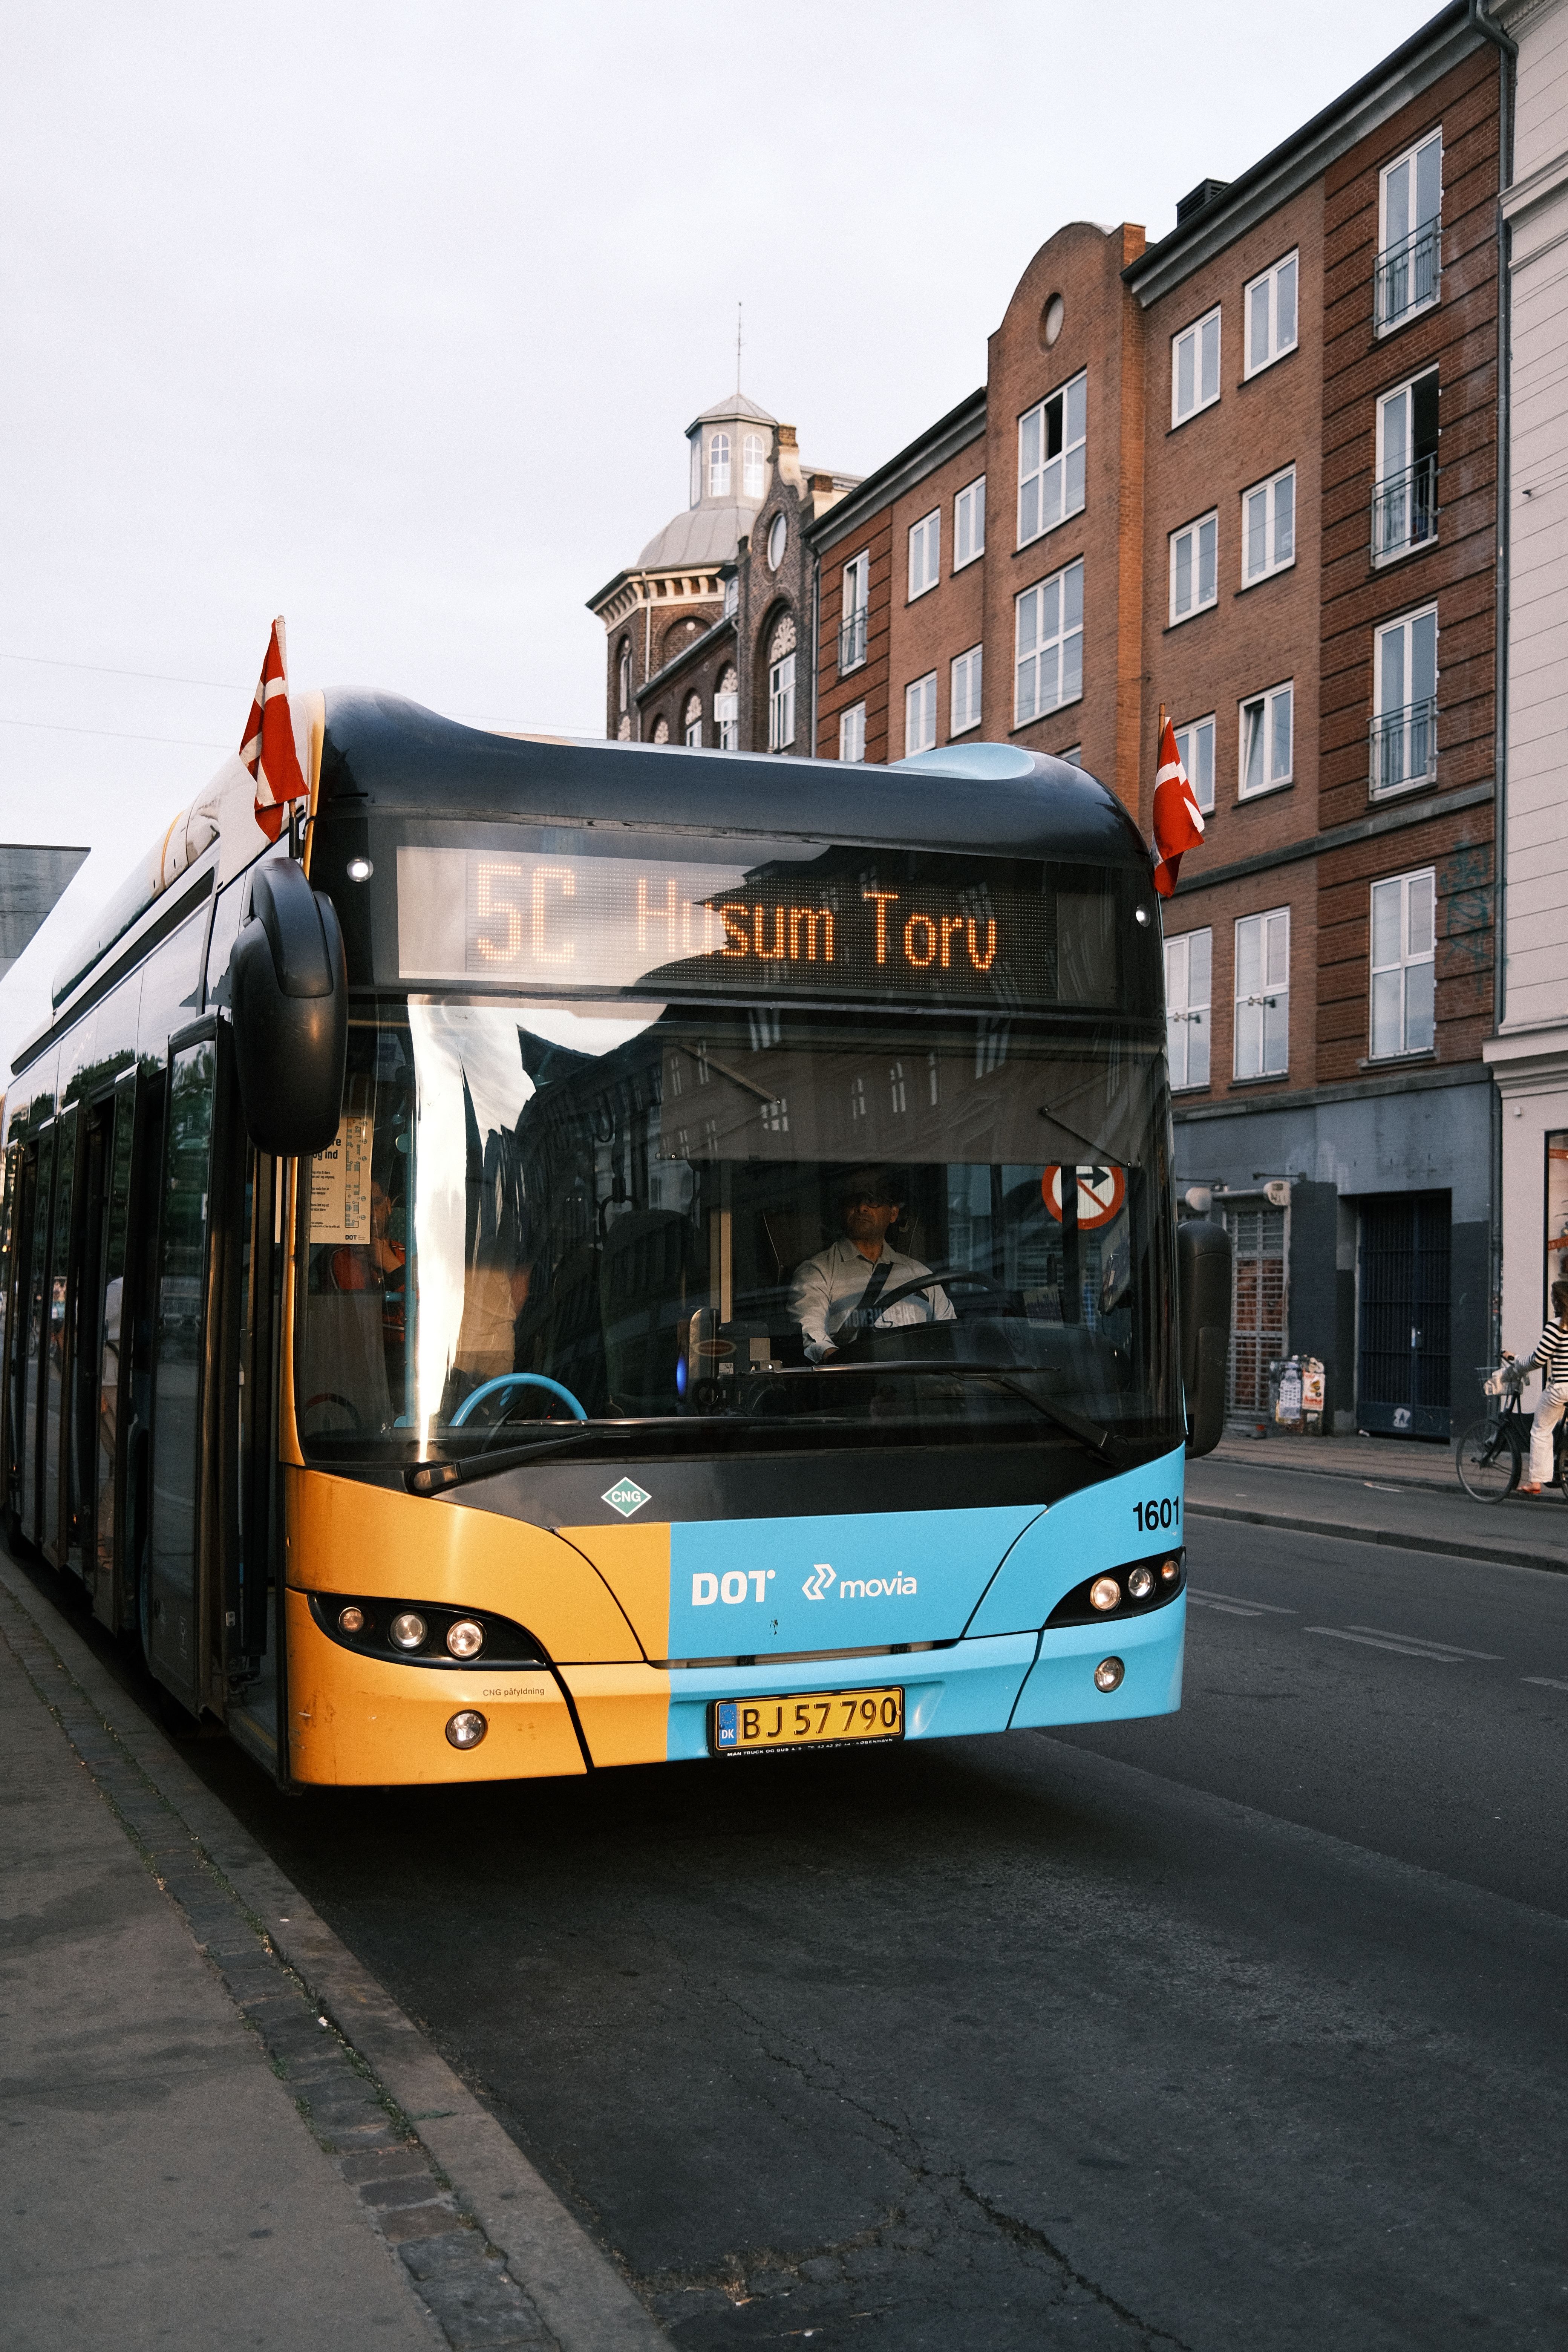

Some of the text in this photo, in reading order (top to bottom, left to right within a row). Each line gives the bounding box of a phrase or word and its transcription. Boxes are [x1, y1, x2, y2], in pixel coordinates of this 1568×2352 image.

[478, 863, 996, 970] 5C Husum Torv
[325, 1149, 338, 1159] ind
[611, 1491, 641, 1502] CNG
[1133, 1496, 1179, 1531] 1601
[692, 1569, 776, 1606] DOT
[840, 1571, 917, 1599] movia
[504, 1687, 545, 1697] påfyldning
[742, 1697, 896, 1739] BJ 57 790
[721, 1729, 735, 1739] DK
